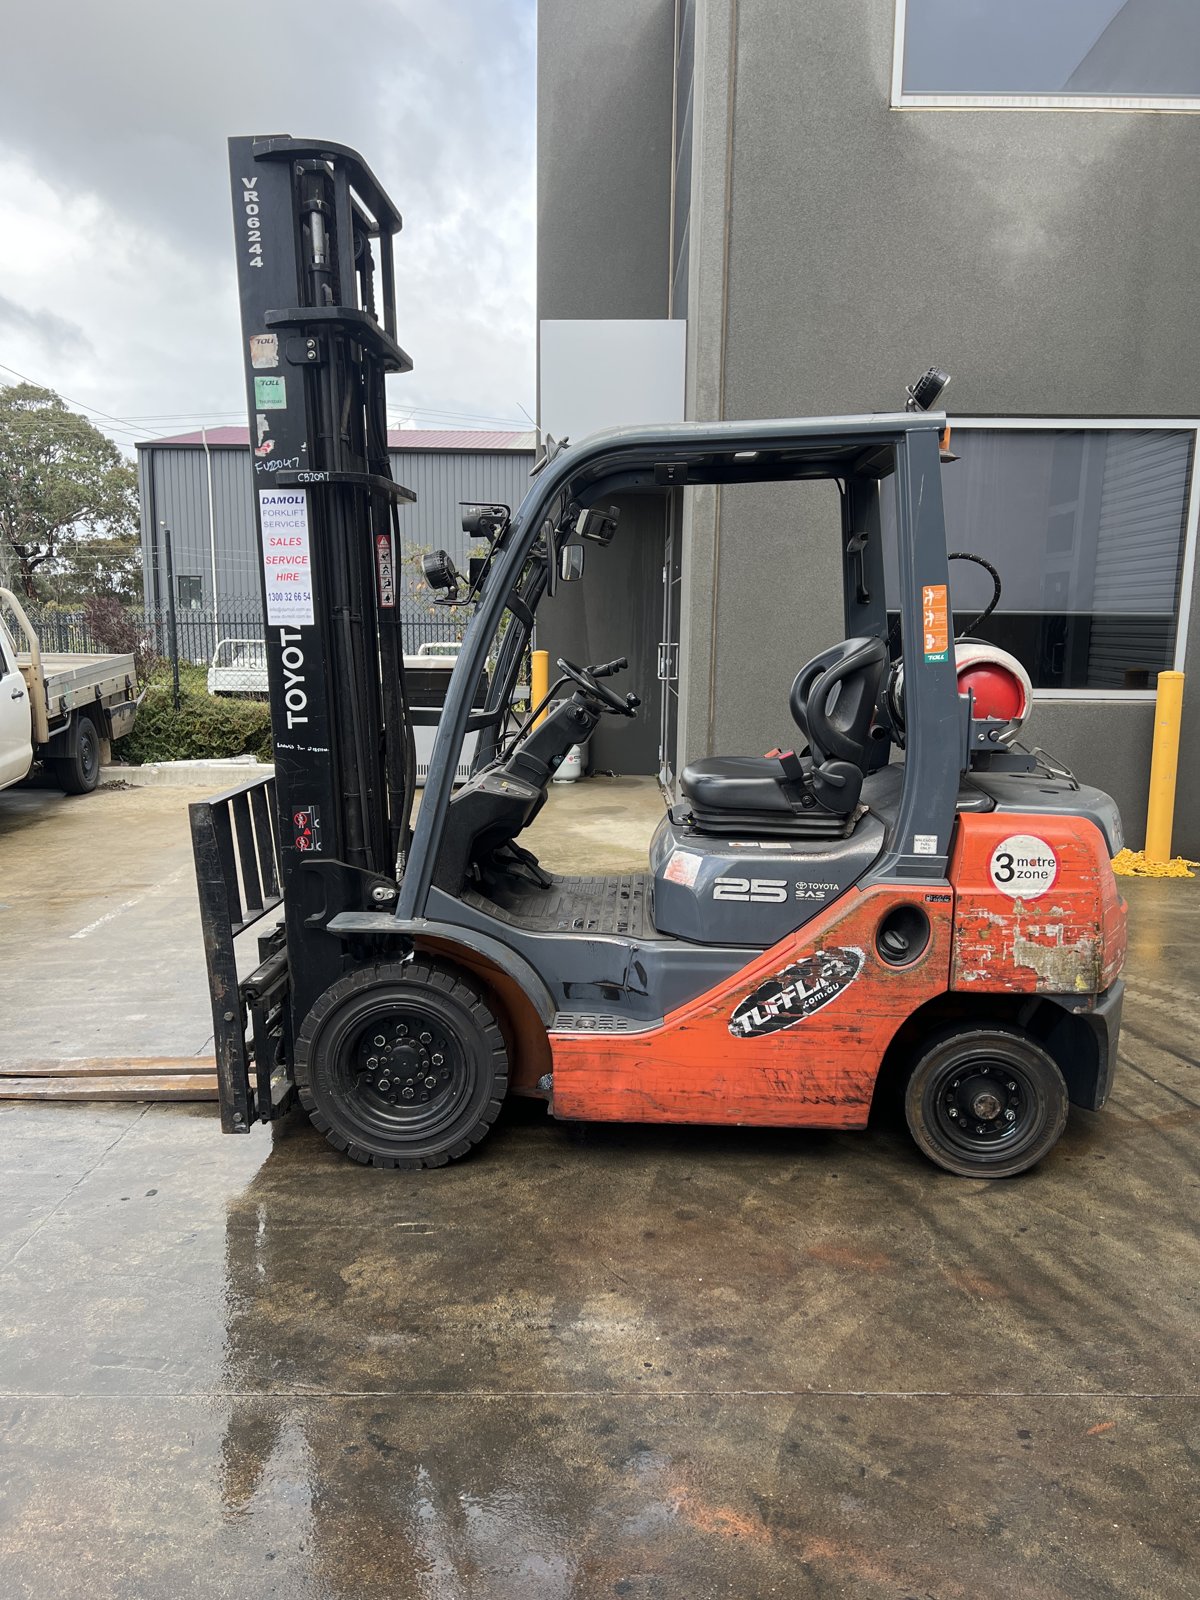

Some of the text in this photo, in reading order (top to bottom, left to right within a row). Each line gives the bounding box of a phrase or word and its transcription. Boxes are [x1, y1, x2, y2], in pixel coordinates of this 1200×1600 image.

[241, 177, 264, 268] VR06244
[262, 496, 305, 505] DAMOLI
[262, 509, 305, 517] FORKLIFT
[263, 520, 306, 528] SERVICES
[269, 537, 302, 546] SALES
[265, 556, 309, 565] SERVICE
[276, 573, 300, 581] HIRE
[268, 592, 311, 601] 1300 32 66 54
[280, 625, 309, 729] TOYOT
[994, 853, 1015, 882] 3
[1016, 870, 1049, 879] zone
[713, 877, 788, 904] 25
[808, 882, 839, 890] TOYOTA
[795, 890, 825, 898] SAS
[802, 982, 840, 1009] .com.au
